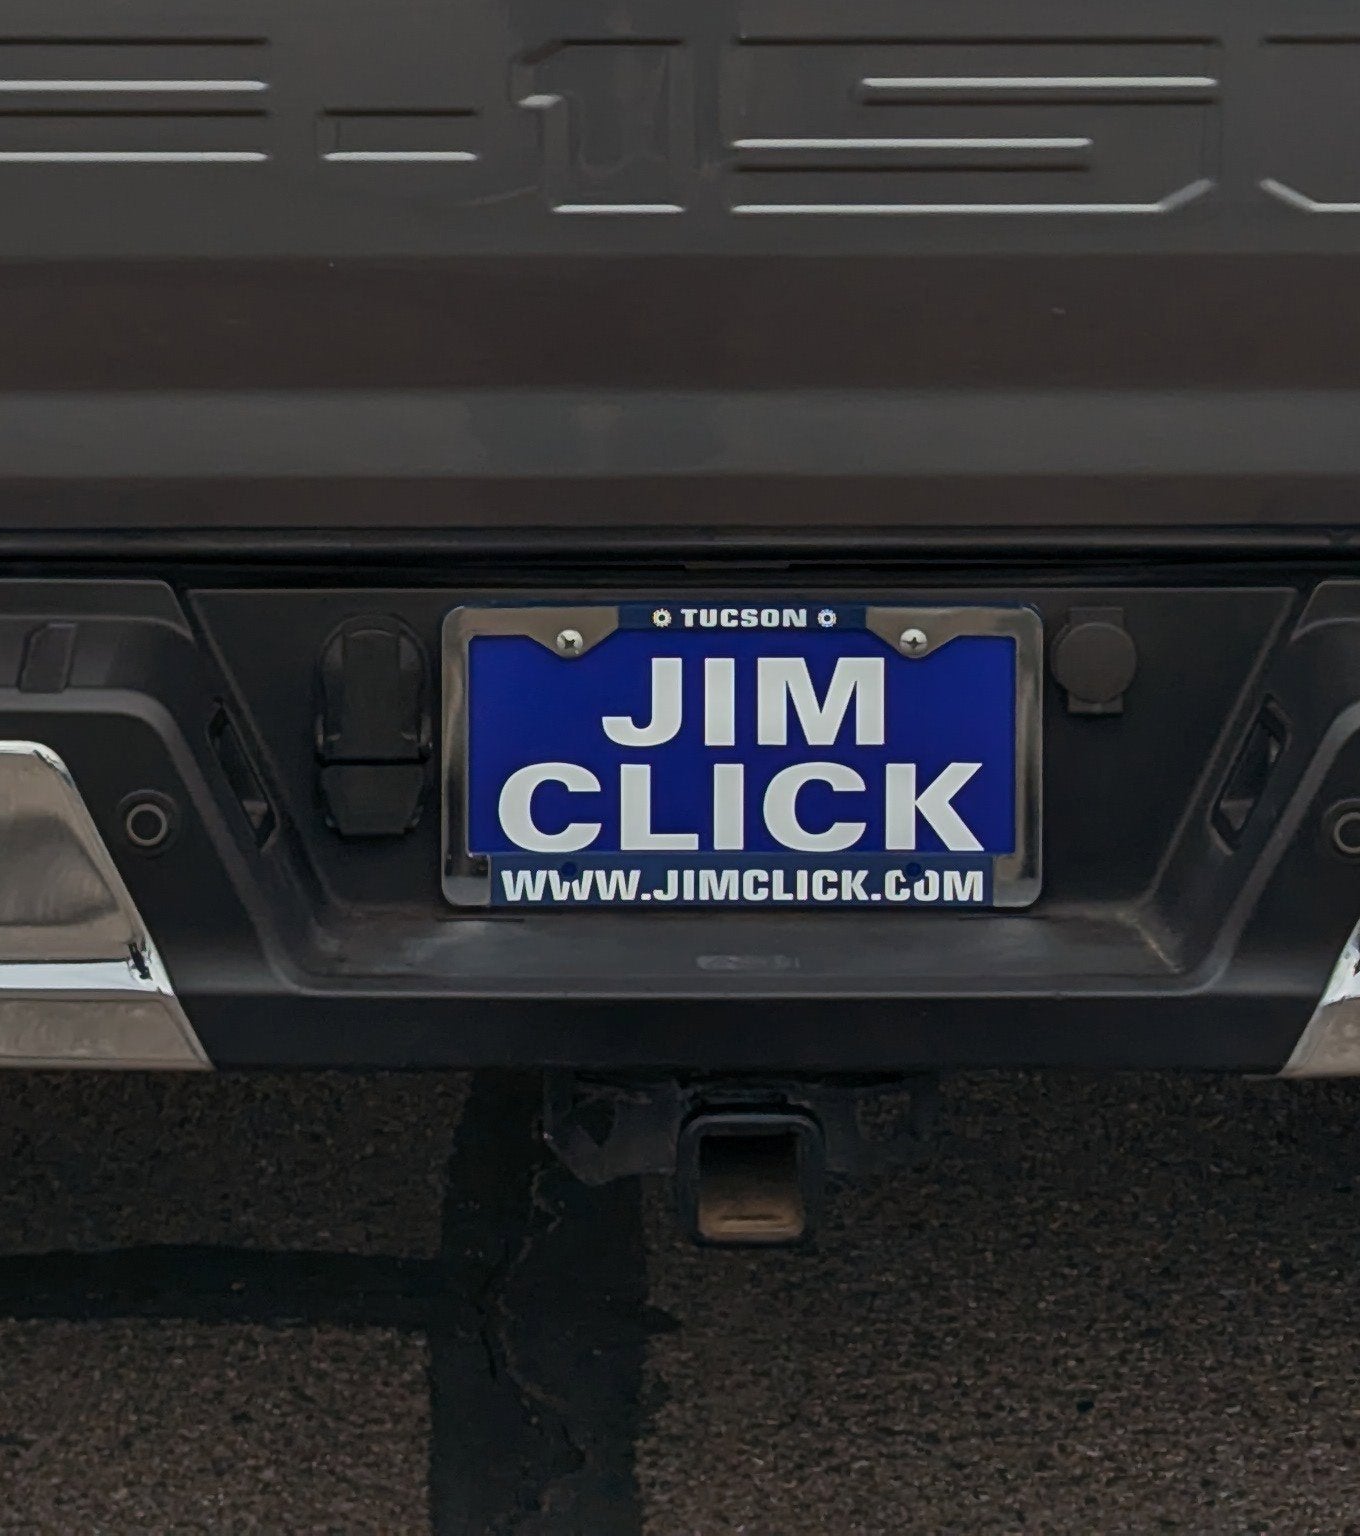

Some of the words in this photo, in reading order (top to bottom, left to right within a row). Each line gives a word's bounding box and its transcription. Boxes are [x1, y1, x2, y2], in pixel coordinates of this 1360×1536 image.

[681, 608, 807, 628] TUCSON
[601, 657, 885, 746] JIM
[497, 762, 984, 852] CLICK
[501, 869, 984, 902] WWW.JIMCLICK.COM
